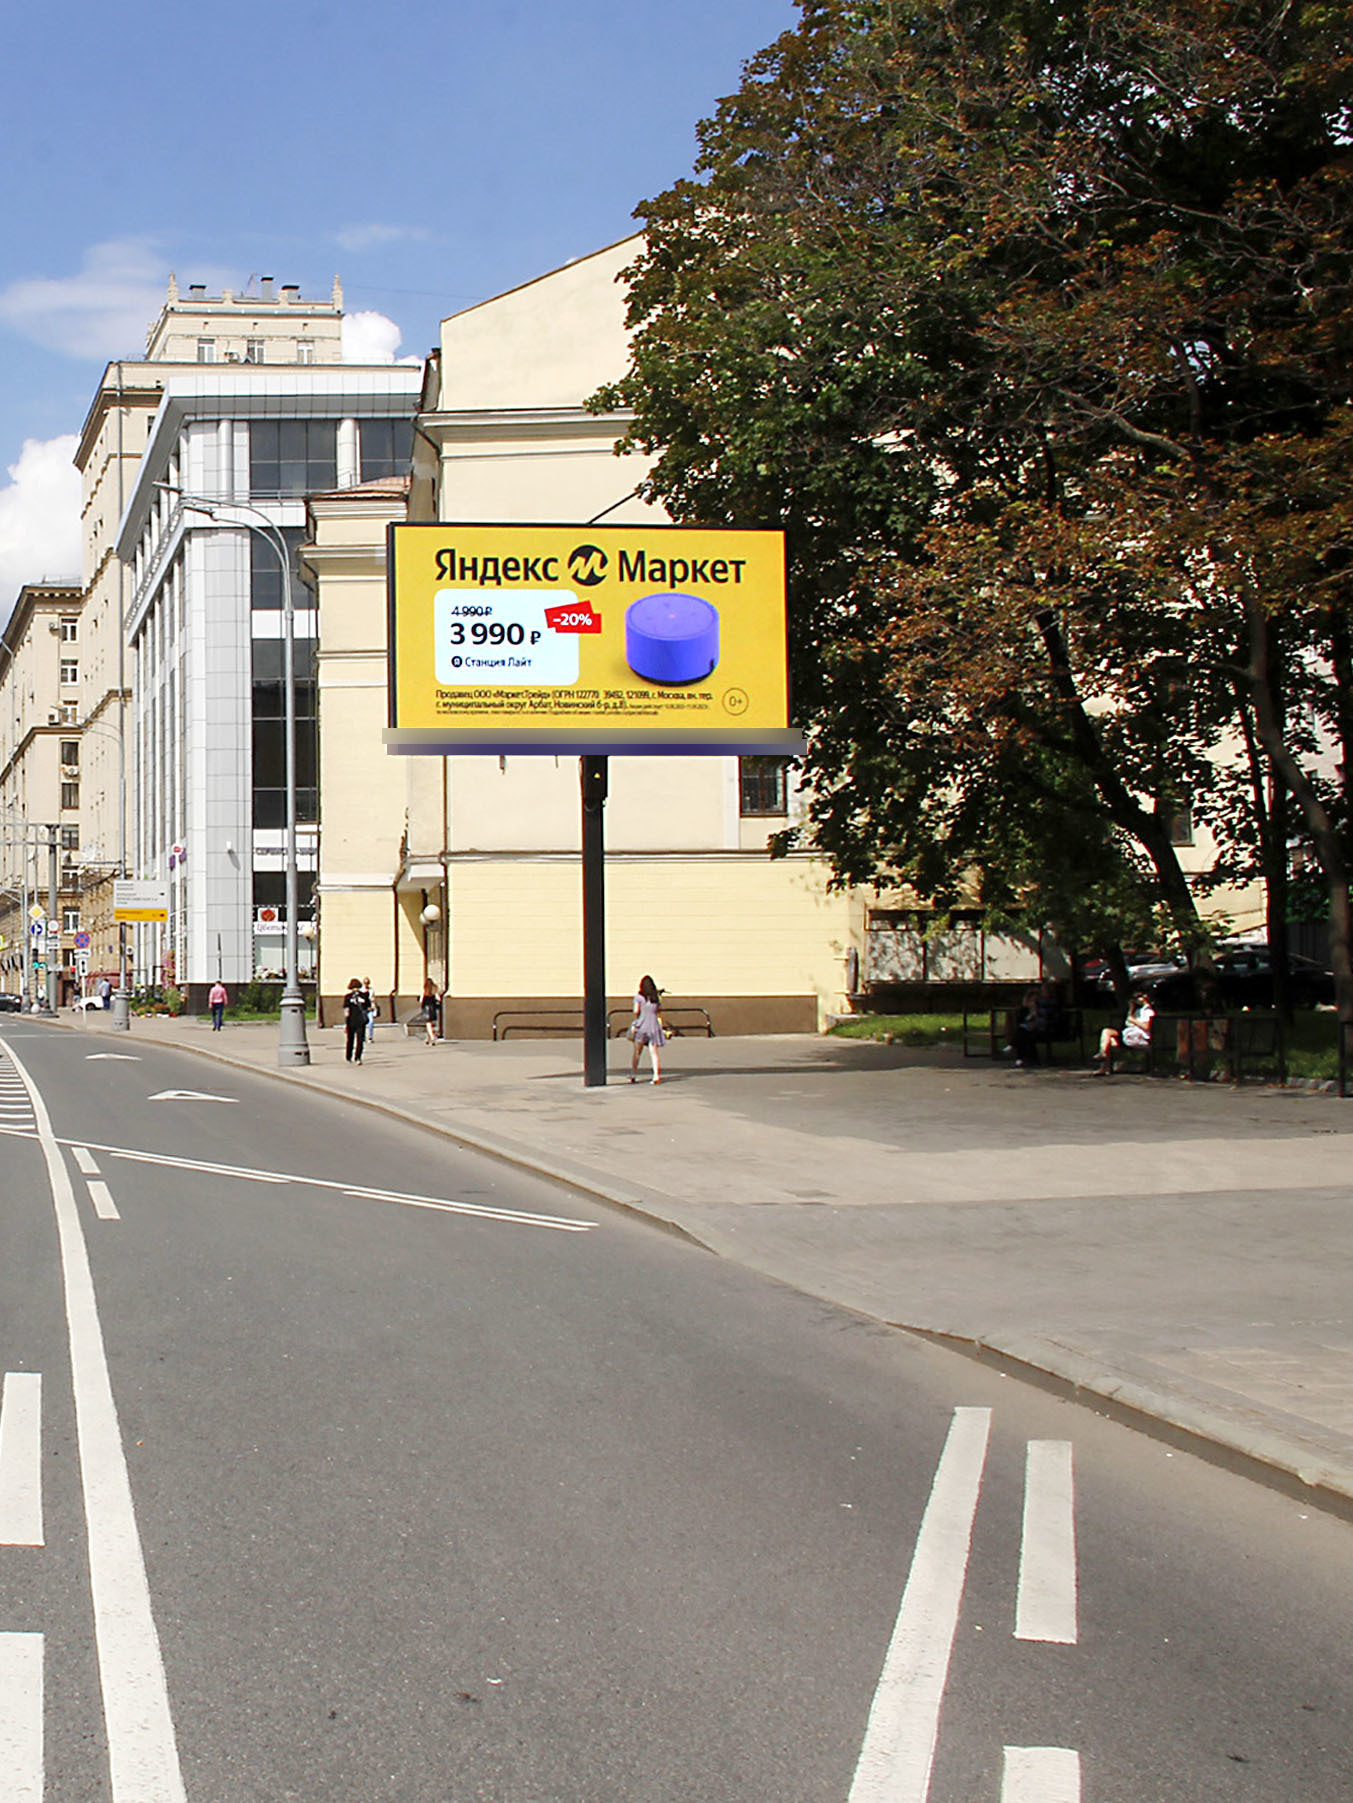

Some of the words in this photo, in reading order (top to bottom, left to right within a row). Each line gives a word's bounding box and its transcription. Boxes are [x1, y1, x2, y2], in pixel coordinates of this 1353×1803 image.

[435, 548, 559, 586] Яндекс
[618, 550, 746, 589] Маркет
[464, 656, 505, 668] Станция
[507, 656, 532, 667] Лайт
[729, 695, 742, 707] 0+
